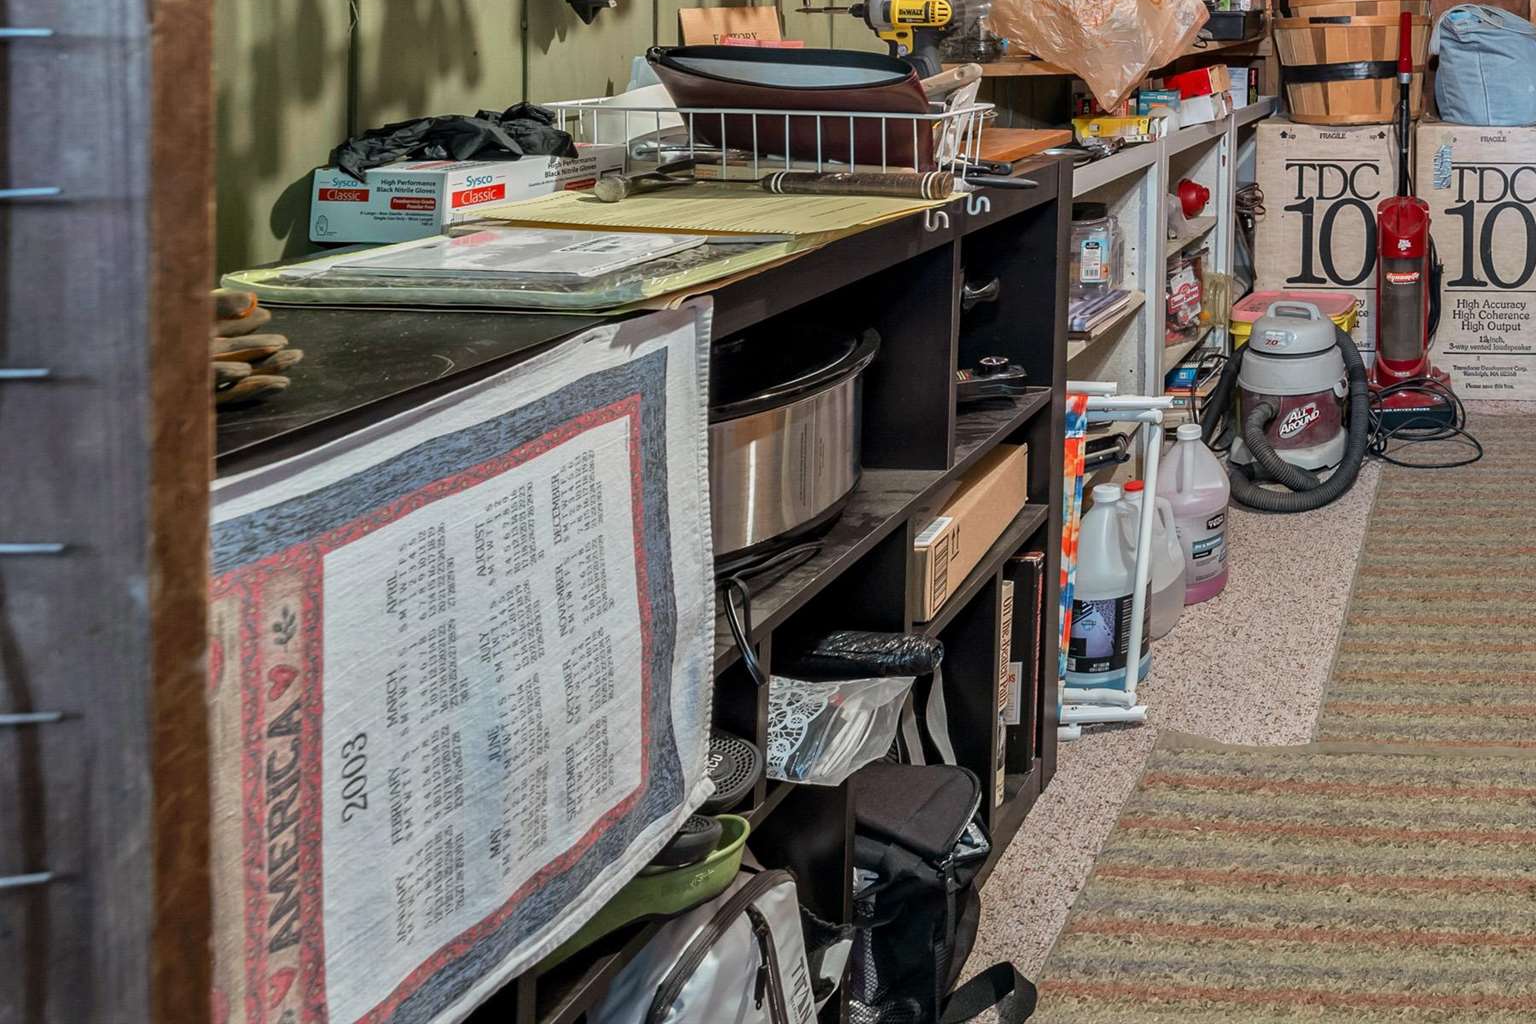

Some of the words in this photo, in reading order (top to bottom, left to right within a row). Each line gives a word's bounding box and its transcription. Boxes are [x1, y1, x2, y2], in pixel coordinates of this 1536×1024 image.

[327, 189, 361, 201] Classic
[332, 177, 358, 188] Sysco
[397, 179, 436, 187] Performance
[461, 188, 497, 205] Classic
[466, 174, 493, 188] Sysco
[1285, 162, 1380, 201] TDC
[1283, 196, 1377, 287] 10
[1452, 310, 1476, 322] High
[1478, 310, 1530, 320] Coherence
[1456, 299, 1480, 311] High
[1482, 299, 1526, 311] Accuracy
[1461, 321, 1485, 333] High
[1487, 321, 1521, 333] Output
[1493, 344, 1532, 352] loudspeaker
[1280, 409, 1320, 435] AROUND
[1288, 406, 1309, 423] ALL
[551, 472, 562, 545] DECEMBER
[474, 522, 487, 576] AUGUST
[386, 570, 397, 614] APRIL
[554, 562, 568, 637] NOVEMBER
[479, 632, 492, 664] JULY
[386, 670, 398, 727] MARCH
[562, 658, 576, 724] OCTOBER
[488, 725, 502, 762] JUNE
[340, 732, 368, 823] 2003
[565, 743, 578, 823] SEPTEMBER
[386, 766, 403, 845] FEBRUARY
[265, 697, 302, 954] AMERICA
[488, 826, 502, 859] MAY
